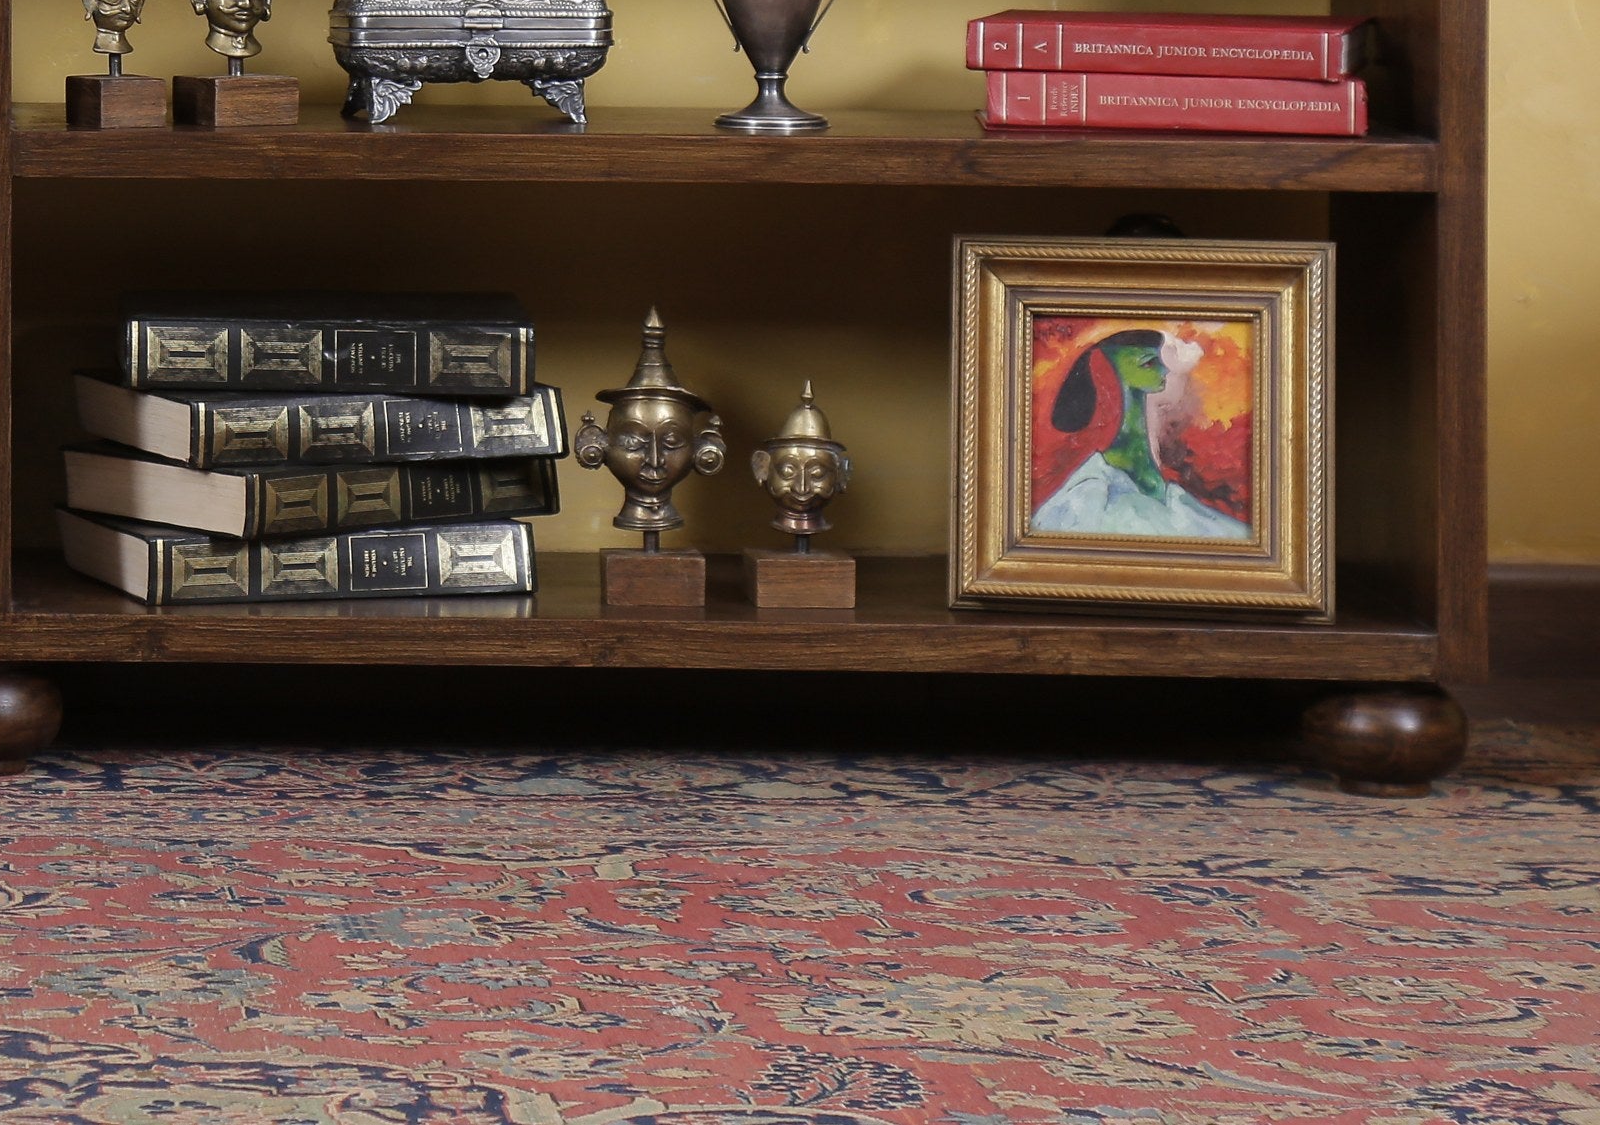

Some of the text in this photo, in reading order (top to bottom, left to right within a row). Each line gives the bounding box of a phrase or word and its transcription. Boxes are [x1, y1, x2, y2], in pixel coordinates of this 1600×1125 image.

[993, 42, 1008, 50] 2
[1074, 43, 1154, 55] BRITANNICA
[1156, 45, 1207, 59] JUNIOR
[1050, 87, 1058, 110] Ready
[1060, 80, 1068, 117] Reference
[1070, 84, 1079, 113] INDEX
[1100, 95, 1179, 107] BRITANNICA
[1182, 98, 1233, 110] JUNIOR
